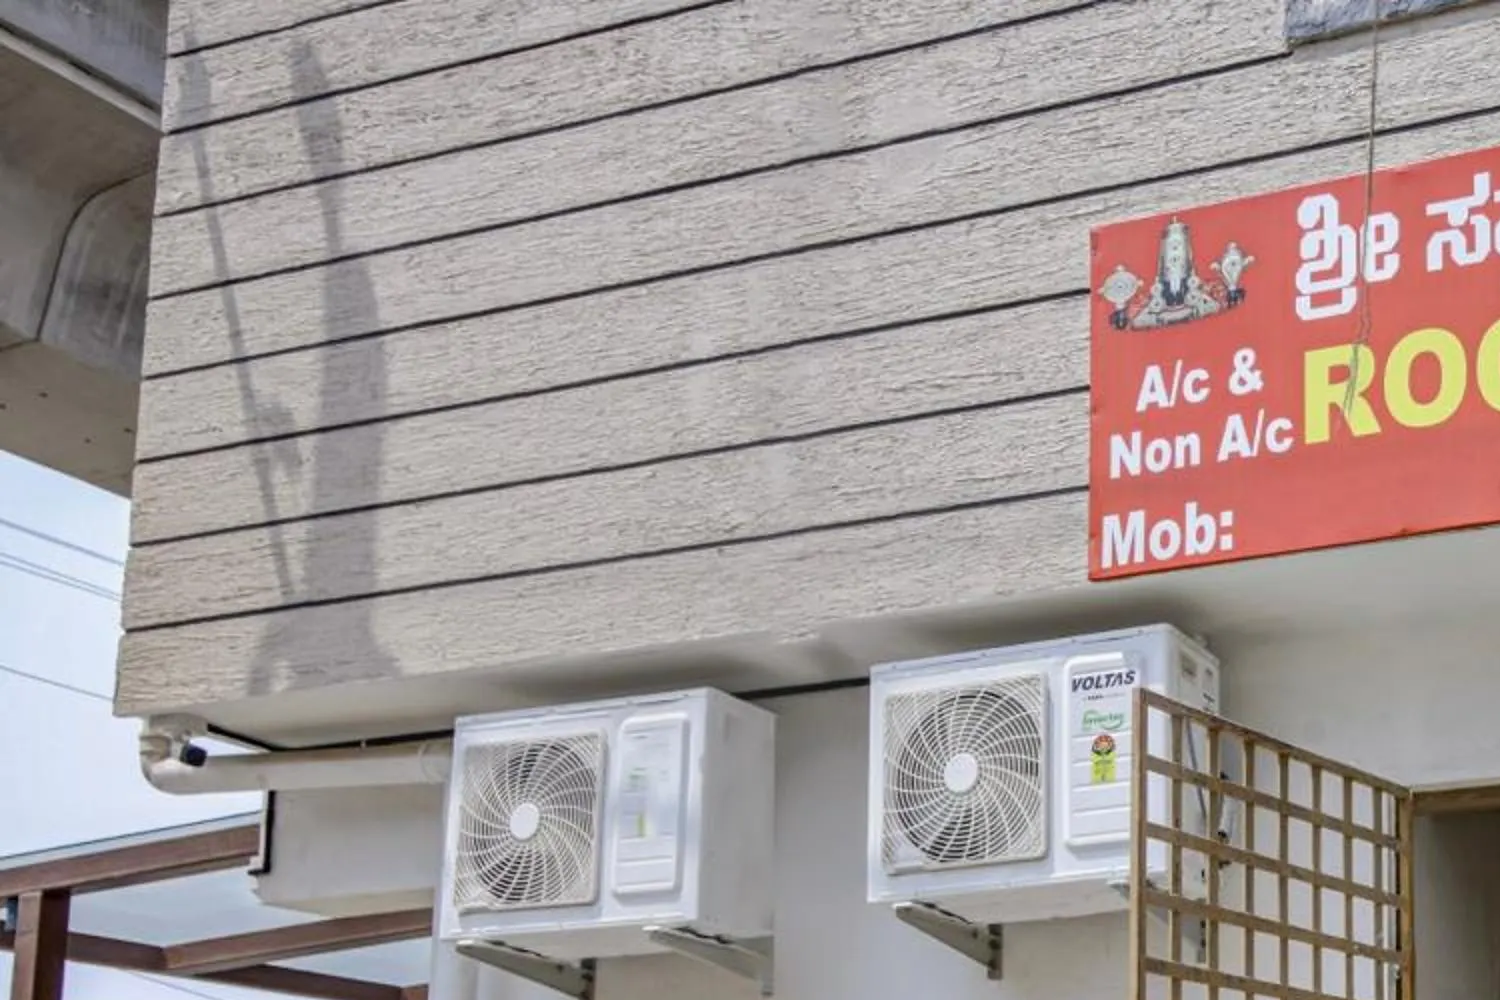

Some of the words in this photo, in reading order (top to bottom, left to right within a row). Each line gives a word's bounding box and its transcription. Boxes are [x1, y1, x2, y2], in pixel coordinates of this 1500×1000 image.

[1295, 192, 1400, 321] ಶ್ರೀ
[1135, 359, 1211, 413] A/c
[1228, 347, 1265, 396] &
[1109, 431, 1201, 479] Non
[1217, 408, 1294, 463] A/c
[1101, 501, 1234, 569] Mob:
[1071, 669, 1136, 693] VOLTAS
